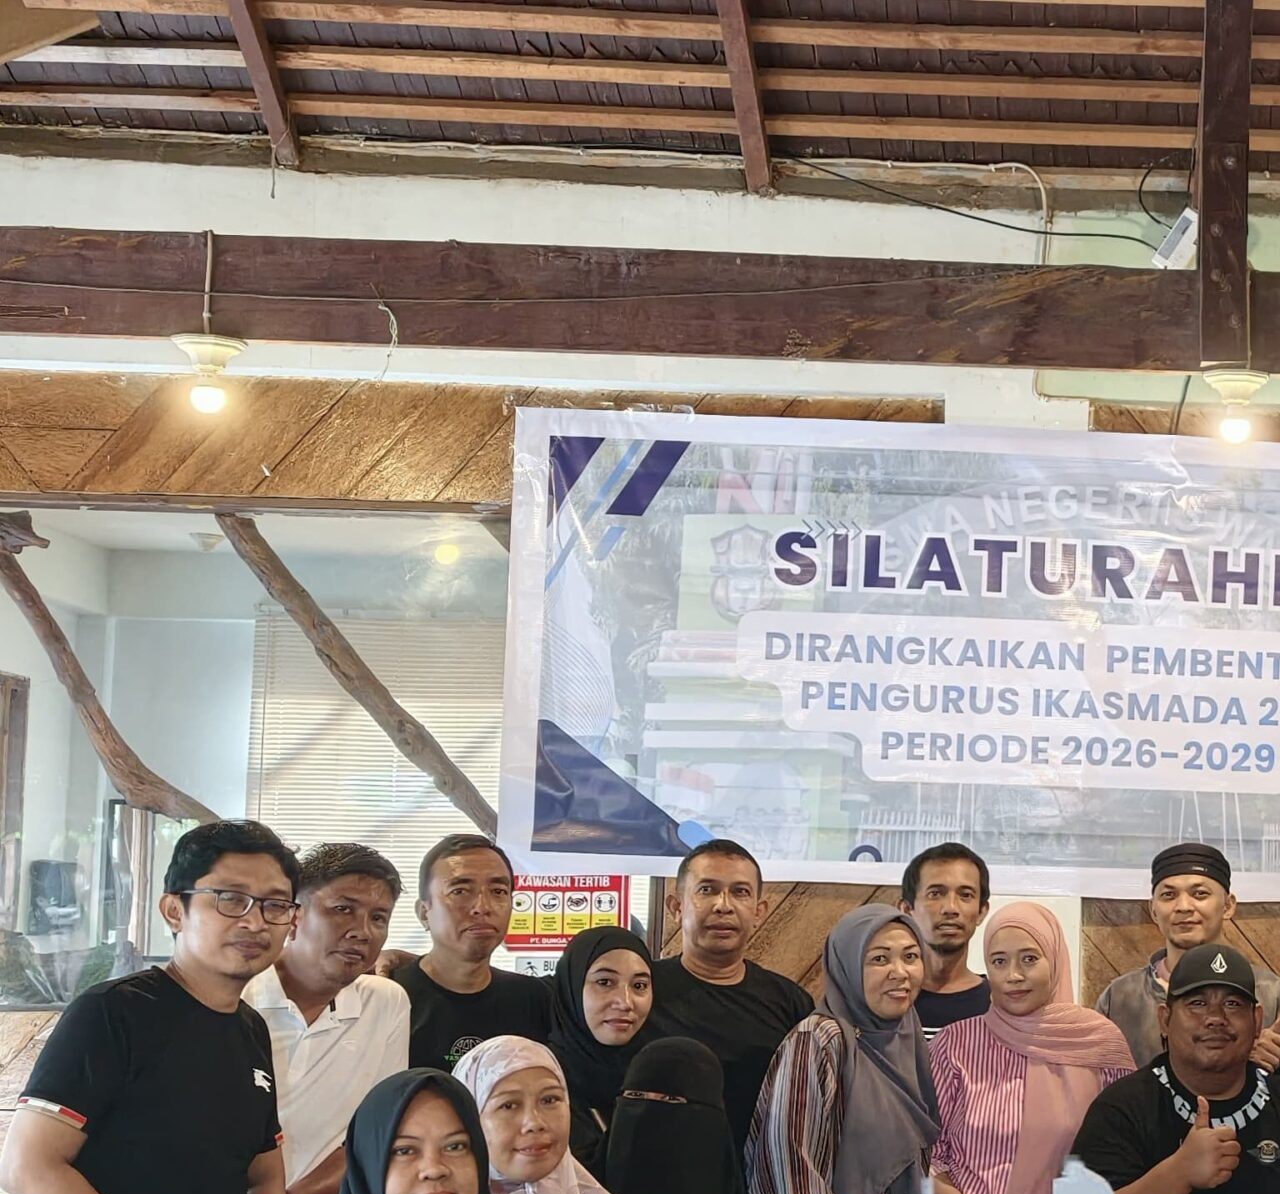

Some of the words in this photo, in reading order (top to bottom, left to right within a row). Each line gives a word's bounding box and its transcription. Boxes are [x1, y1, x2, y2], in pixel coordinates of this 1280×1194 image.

[764, 631, 1085, 672] DIRANGKAIKAN
[801, 681, 1019, 716] PENGURUS
[1033, 687, 1248, 726] IKASMADA
[881, 731, 1050, 766] PERIODE
[517, 875, 571, 888] KAWASAN
[574, 876, 611, 888] TERTIB
